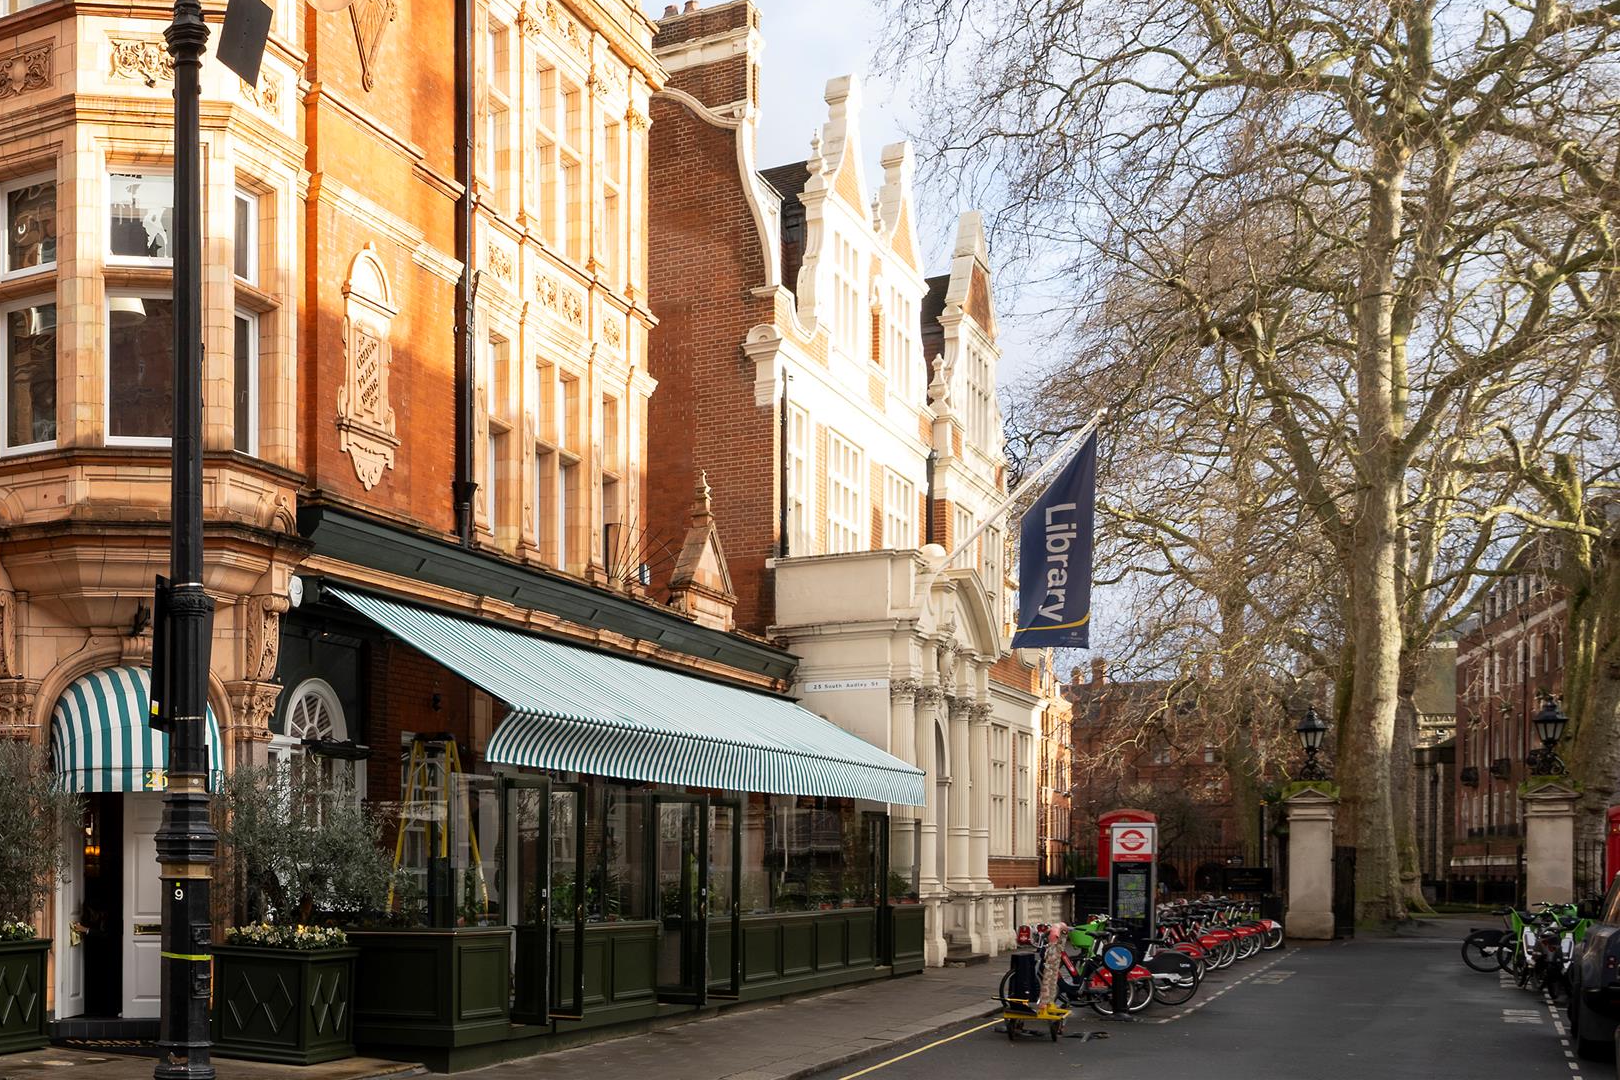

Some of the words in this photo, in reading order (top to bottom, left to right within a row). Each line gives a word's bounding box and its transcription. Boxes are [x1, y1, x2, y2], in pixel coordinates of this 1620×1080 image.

[1038, 502, 1077, 622] Library
[145, 770, 169, 788] 26
[174, 888, 184, 901] 9
